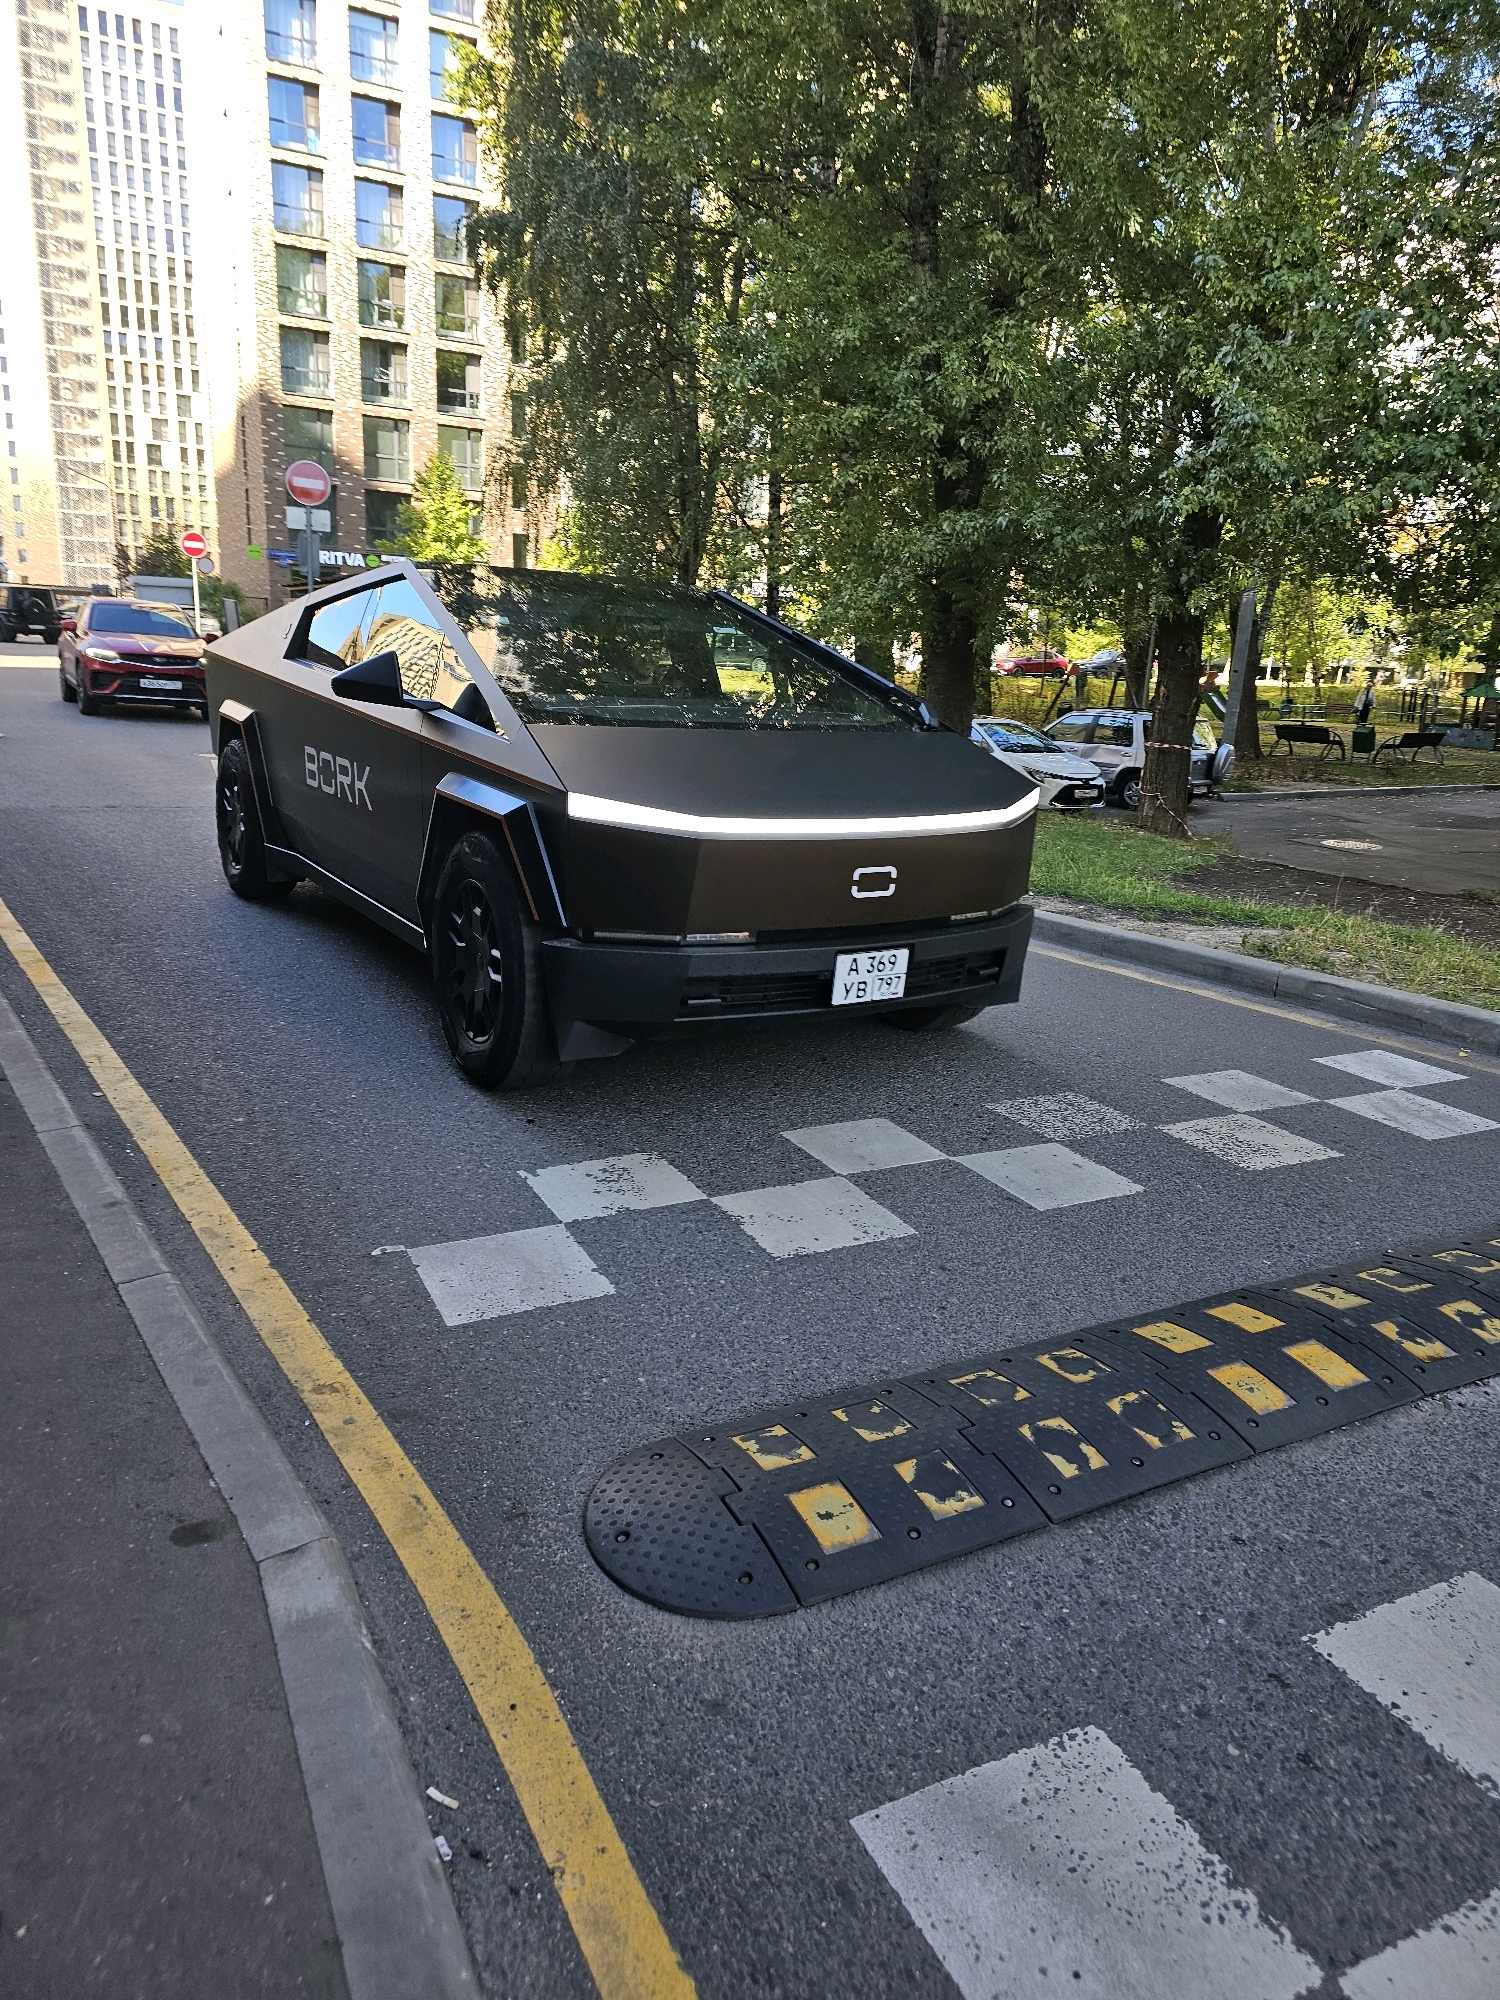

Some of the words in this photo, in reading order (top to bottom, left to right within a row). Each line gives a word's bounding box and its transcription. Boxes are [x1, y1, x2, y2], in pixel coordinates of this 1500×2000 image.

[319, 550, 366, 568] RITVA
[304, 746, 372, 811] BORK
[866, 954, 897, 974] 369
[877, 976, 901, 991] 797
